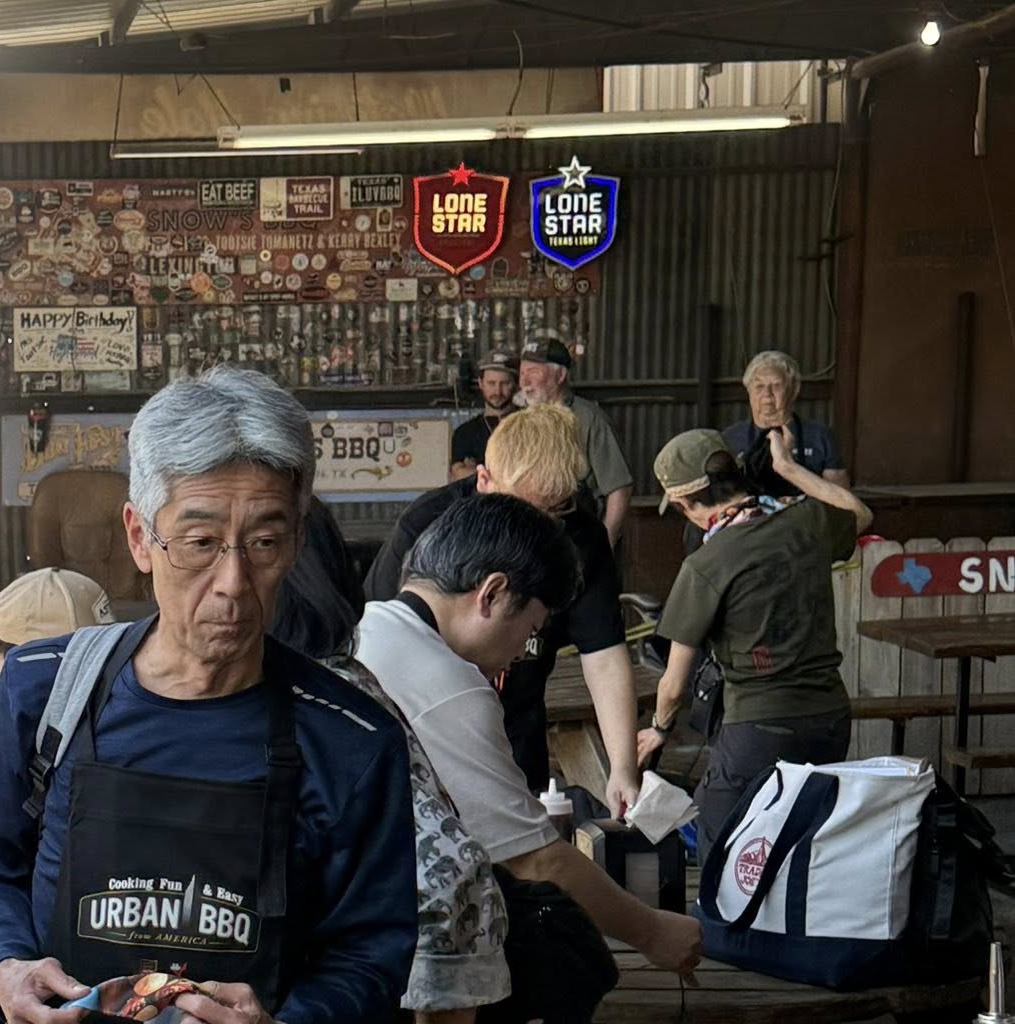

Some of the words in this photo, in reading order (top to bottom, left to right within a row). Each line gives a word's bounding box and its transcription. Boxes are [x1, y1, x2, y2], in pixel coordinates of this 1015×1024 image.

[201, 183, 223, 200] EAT
[225, 182, 254, 200] BEEF
[292, 184, 325, 194] TEXAS
[294, 204, 323, 214] TRAIL
[433, 193, 487, 213] LONE
[545, 193, 602, 214] LONE
[147, 208, 254, 231] SNOW'S
[432, 214, 486, 233] STAR
[545, 214, 602, 235] STAR
[216, 235, 257, 251] TOOTSIE
[549, 236, 572, 247] TEXAS
[575, 235, 597, 247] LIGHT
[21, 312, 72, 329] HAPPY
[332, 436, 380, 462] BBQ
[959, 556, 1015, 594] SN
[108, 877, 154, 891] Cooking
[159, 878, 183, 891] Fun
[202, 884, 213, 896] &
[216, 886, 244, 906] Easy
[90, 897, 181, 930] URBAN
[198, 903, 251, 945] BBQ
[127, 930, 152, 941] from
[154, 933, 207, 945] AMERICA
